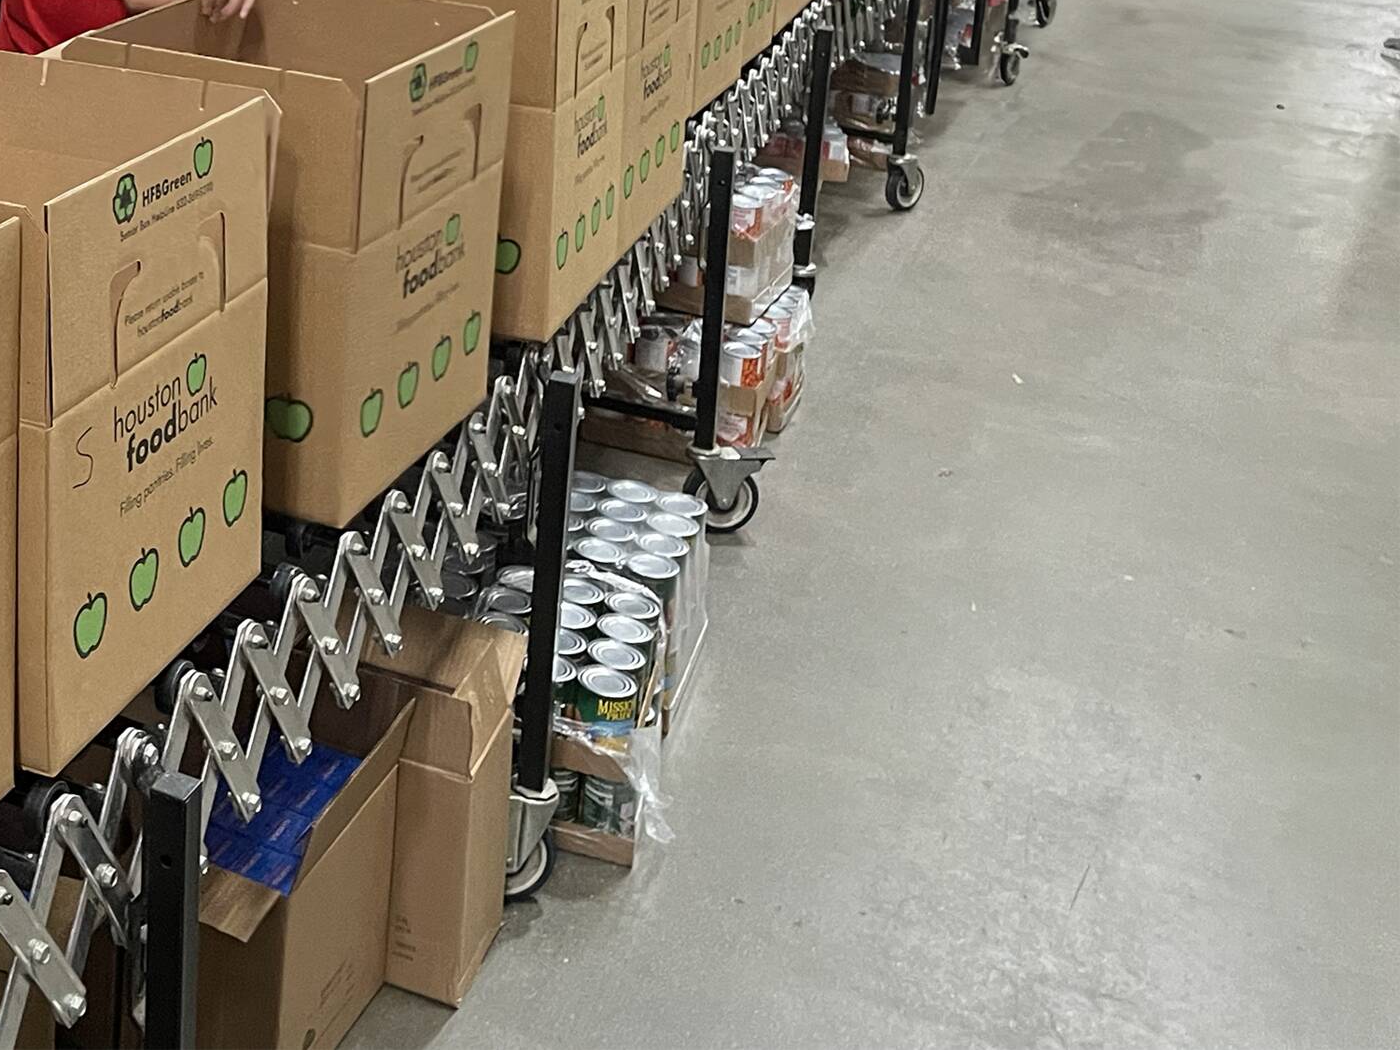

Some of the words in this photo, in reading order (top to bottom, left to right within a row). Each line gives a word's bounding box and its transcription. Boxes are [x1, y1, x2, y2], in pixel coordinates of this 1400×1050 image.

[142, 171, 192, 208] HFBGreen
[403, 233, 465, 299] foodbank
[113, 376, 181, 442] houston
[126, 375, 218, 473] foodbank
